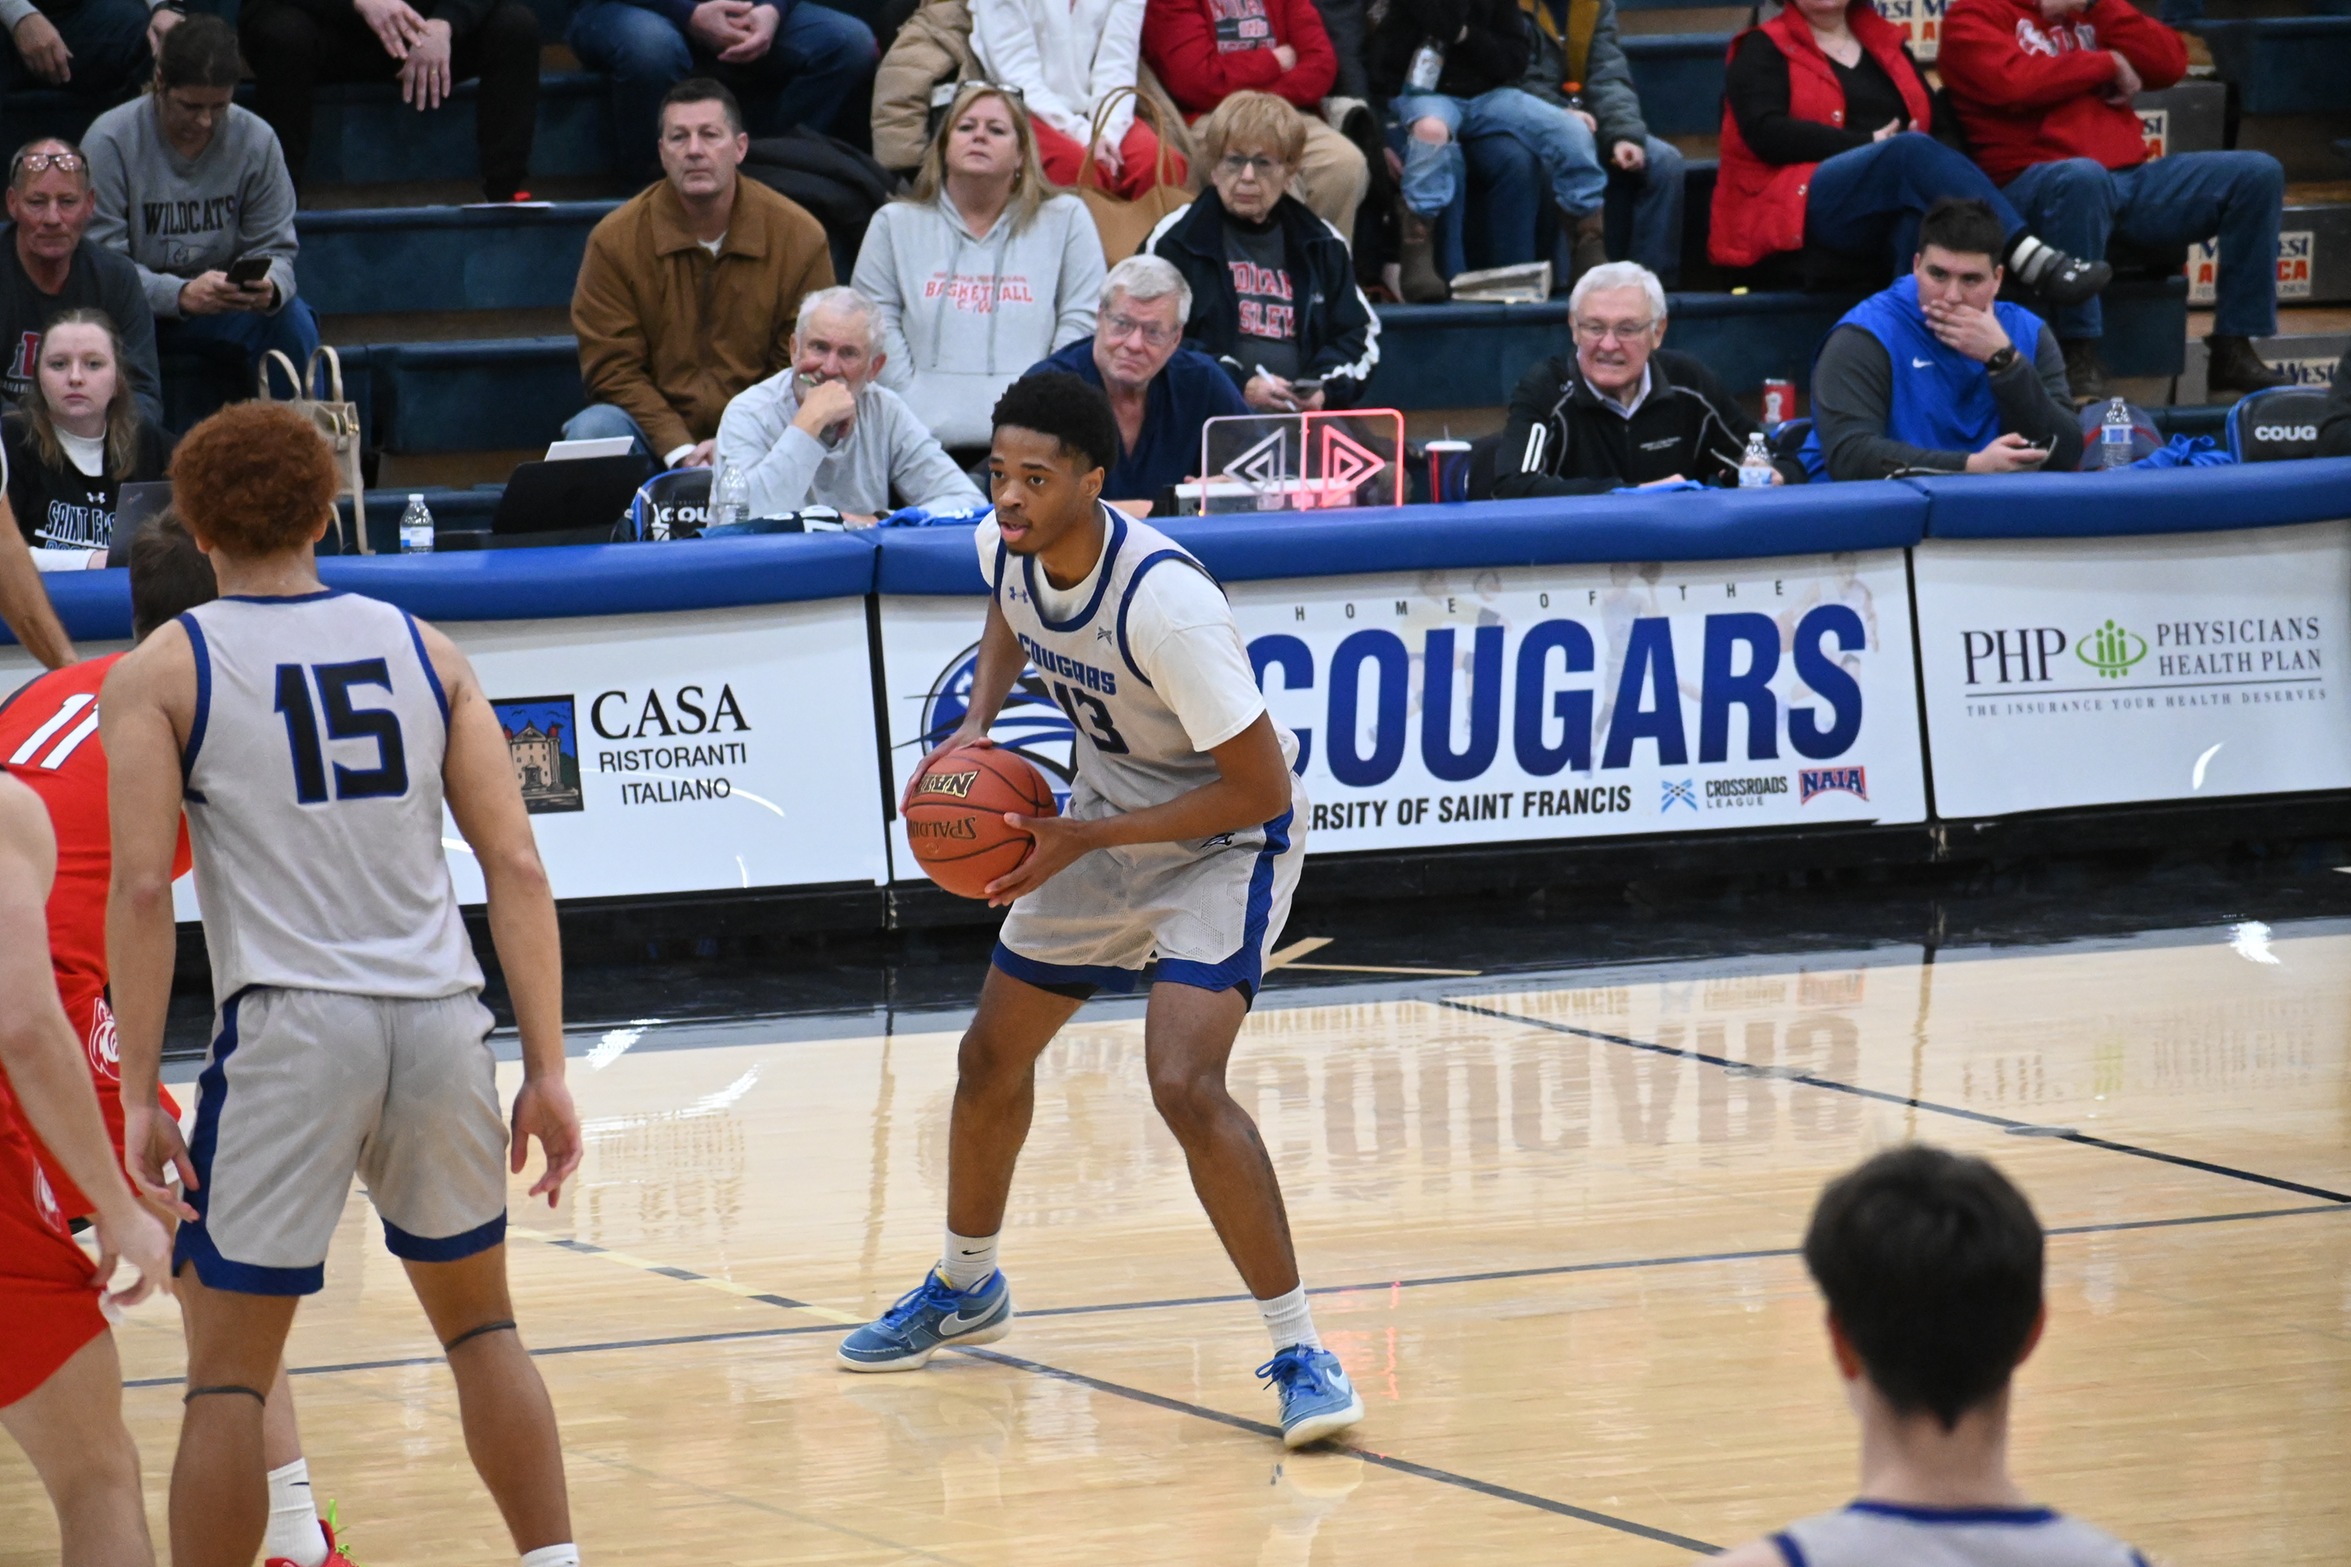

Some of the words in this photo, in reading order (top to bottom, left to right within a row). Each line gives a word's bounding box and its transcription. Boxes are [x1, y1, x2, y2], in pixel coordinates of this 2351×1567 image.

[1295, 597, 1456, 621] HOME
[1540, 590, 1596, 609] OF
[1679, 580, 1784, 601] THE
[2157, 616, 2319, 647] PHYSICIANS
[1018, 632, 1117, 696] COUGARS
[1961, 627, 2067, 685] PHP
[2159, 651, 2253, 676] HEALTH
[2262, 649, 2322, 672] PLAN
[591, 683, 752, 740] CASA
[1246, 604, 1866, 788] COUGARS
[1966, 704, 1998, 717] THE
[2008, 700, 2102, 716] INSURANCE
[2112, 697, 2155, 710] YOUR
[2166, 693, 2231, 708] HEALTH
[2242, 688, 2326, 704] DESERVES
[8, 693, 99, 770] 11
[274, 657, 409, 804] 15
[1053, 680, 1130, 755] 13
[599, 742, 746, 773] RISTORANTI
[622, 777, 731, 805] ITALIANO
[1705, 776, 1788, 798] CROSSROADS
[1707, 796, 1764, 809] LEAGUE
[1801, 768, 1865, 799] NAIA
[1307, 800, 1388, 831] RSITY
[1398, 798, 1429, 826] OF
[1438, 793, 1514, 823] SAINT
[1523, 785, 1632, 818] FRANCIS
